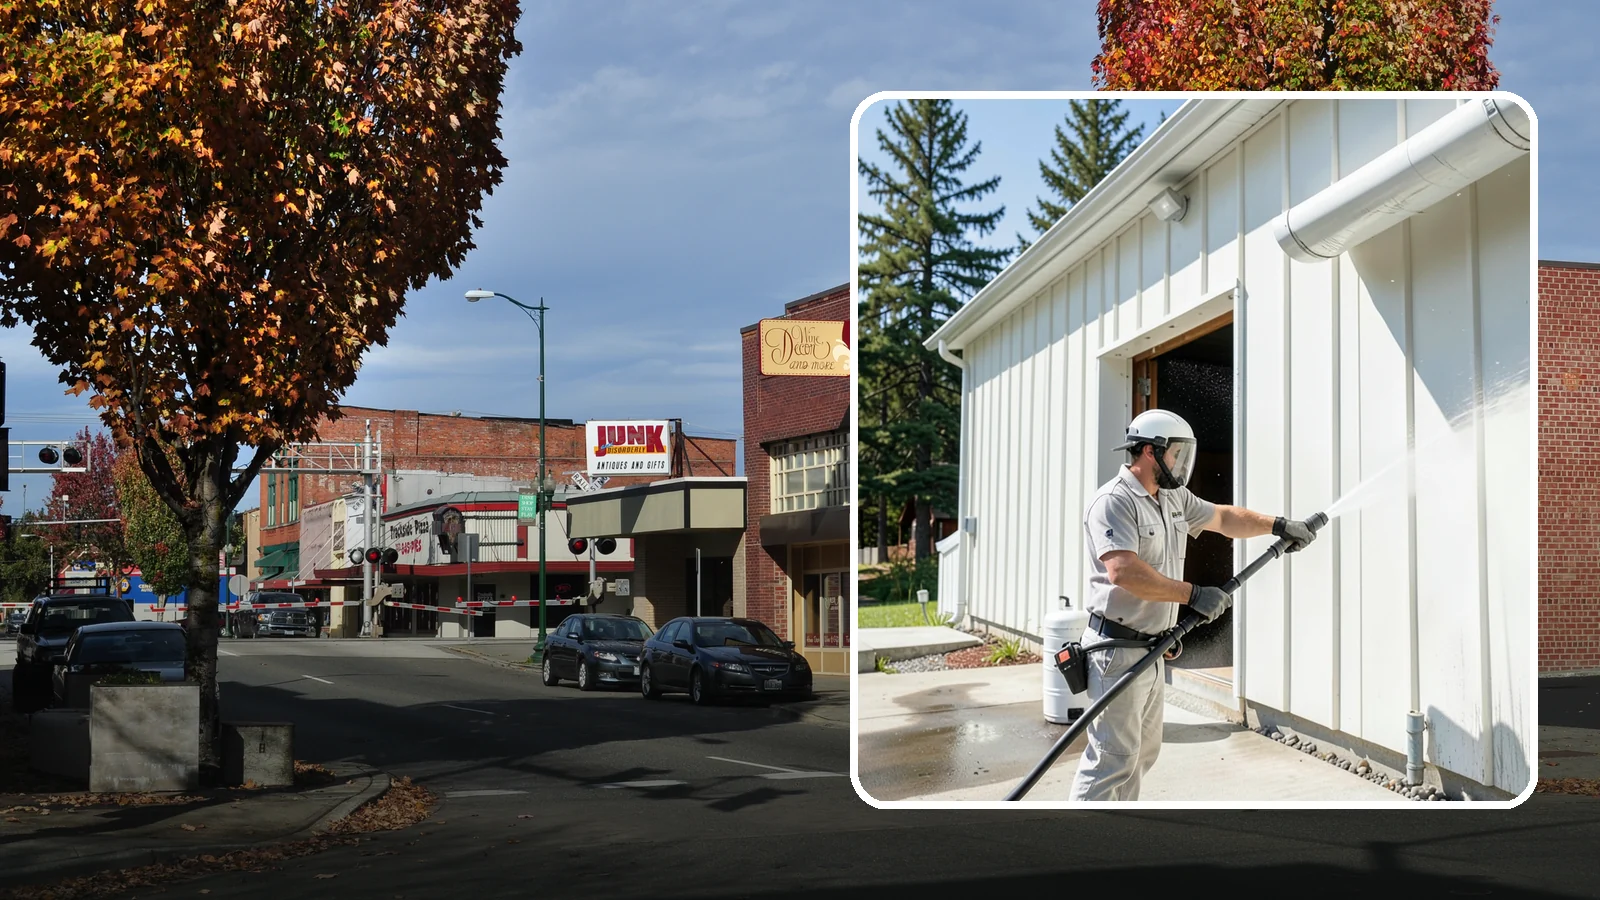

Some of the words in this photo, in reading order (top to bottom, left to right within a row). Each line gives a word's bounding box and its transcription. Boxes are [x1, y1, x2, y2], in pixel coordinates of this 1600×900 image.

[765, 328, 831, 365] Decor
[595, 425, 665, 457] JUNK
[608, 446, 646, 454] DISORDERLY
[597, 461, 628, 470] ANTIQUES
[631, 461, 644, 470] AND
[647, 460, 666, 469] GIFTS
[414, 519, 429, 535] Pizza
